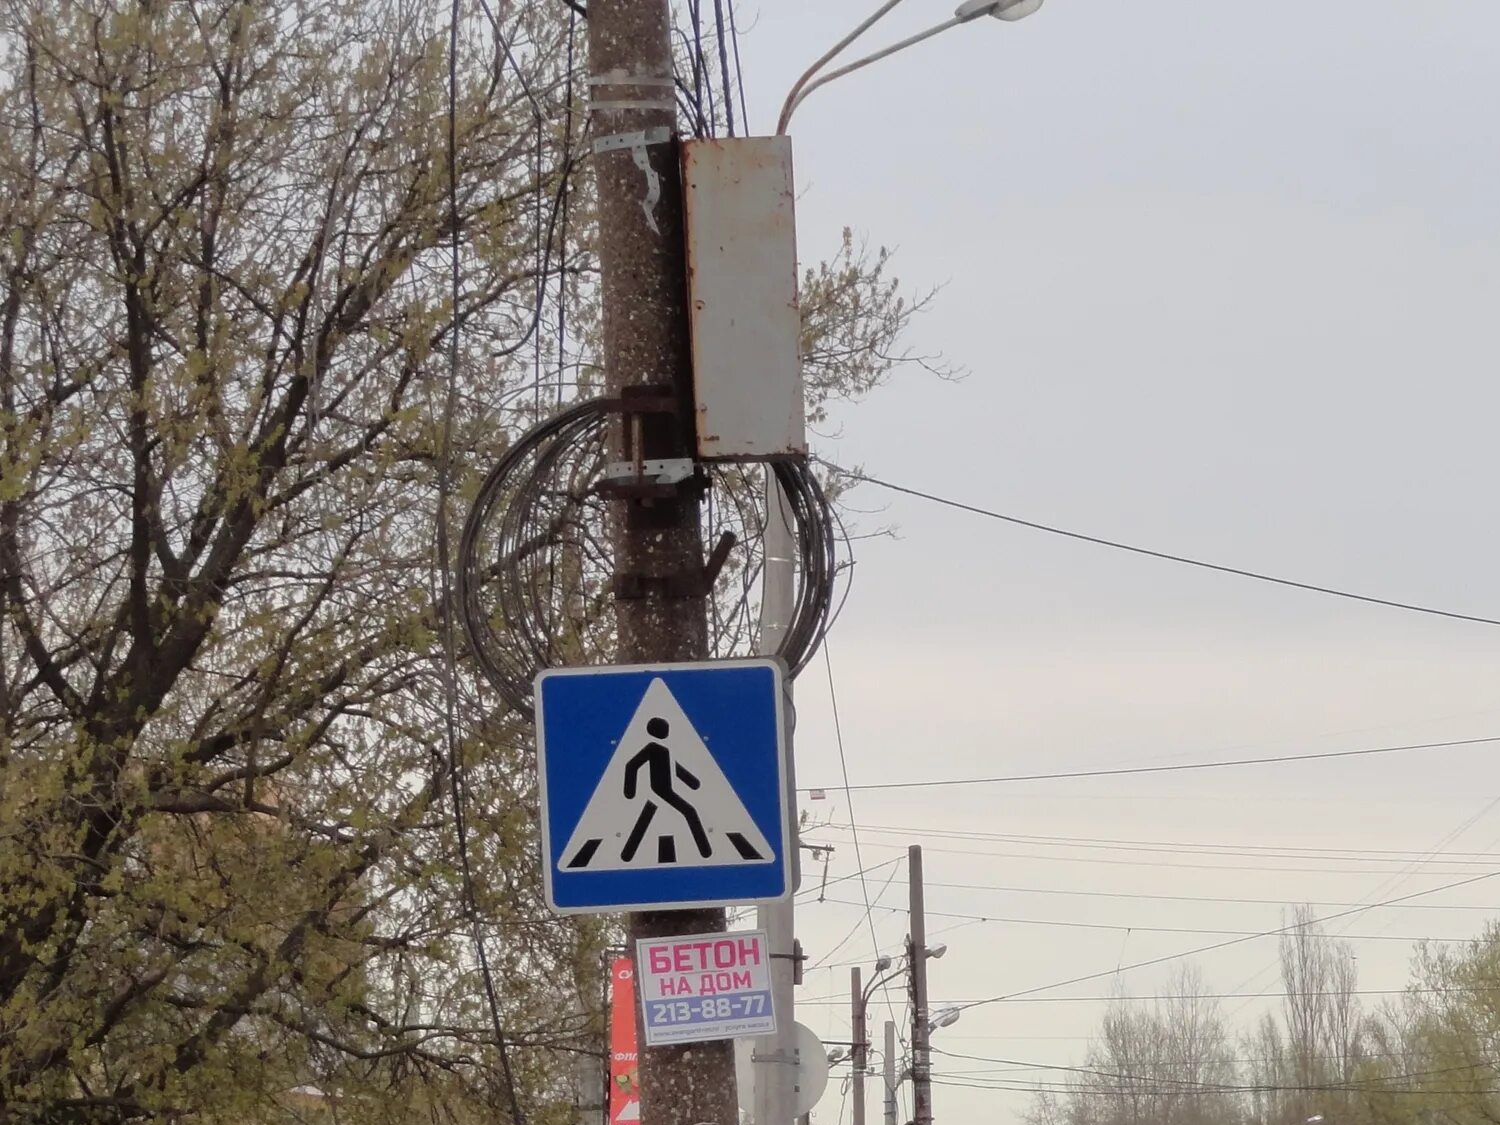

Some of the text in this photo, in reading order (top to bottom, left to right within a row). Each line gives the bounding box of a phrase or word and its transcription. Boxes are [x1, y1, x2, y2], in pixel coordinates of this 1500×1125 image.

[648, 938, 760, 974] БЕТОН
[660, 970, 752, 996] НА ДОМ
[653, 995, 765, 1023] 213-88-77
